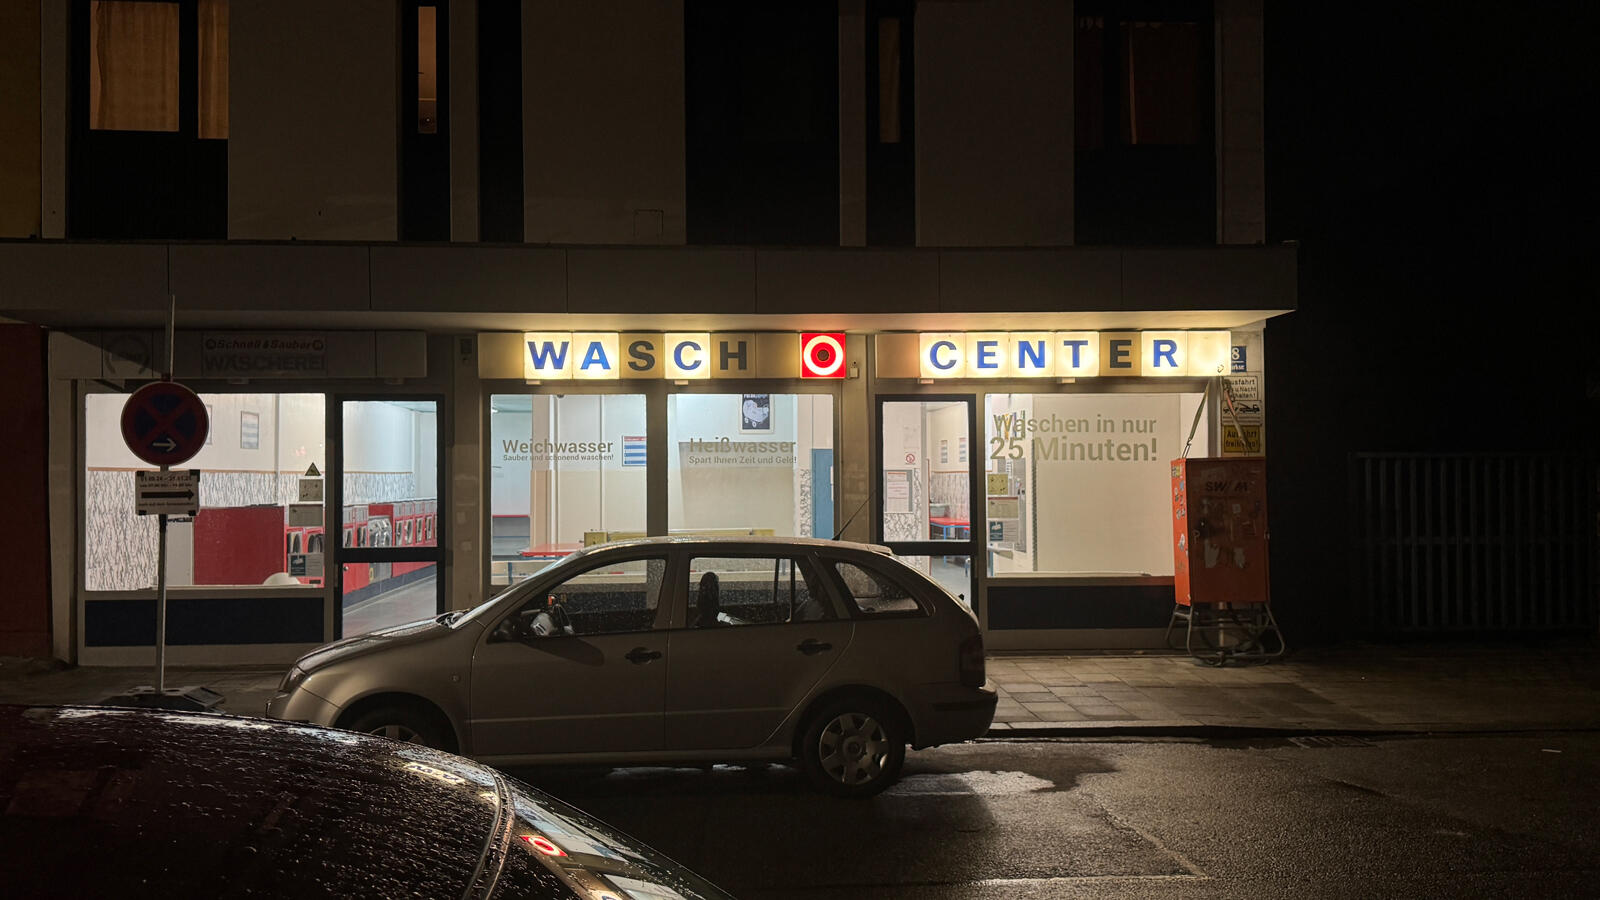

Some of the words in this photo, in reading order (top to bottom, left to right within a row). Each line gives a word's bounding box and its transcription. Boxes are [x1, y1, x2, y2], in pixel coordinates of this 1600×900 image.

[528, 340, 747, 371] WASCH
[930, 339, 1179, 370] CENTER
[993, 413, 1089, 433] Waschen
[1096, 413, 1115, 433] in
[1122, 419, 1157, 433] nur
[502, 438, 614, 453] Weichwasser
[689, 436, 797, 453] Heißwasser
[990, 436, 1024, 460] 25
[1035, 436, 1157, 461] Minuten!
[689, 456, 711, 465] Spart
[714, 456, 737, 464] Ihnen
[739, 456, 756, 464] Zeit
[757, 456, 773, 464] und
[775, 456, 797, 464] Geld!
